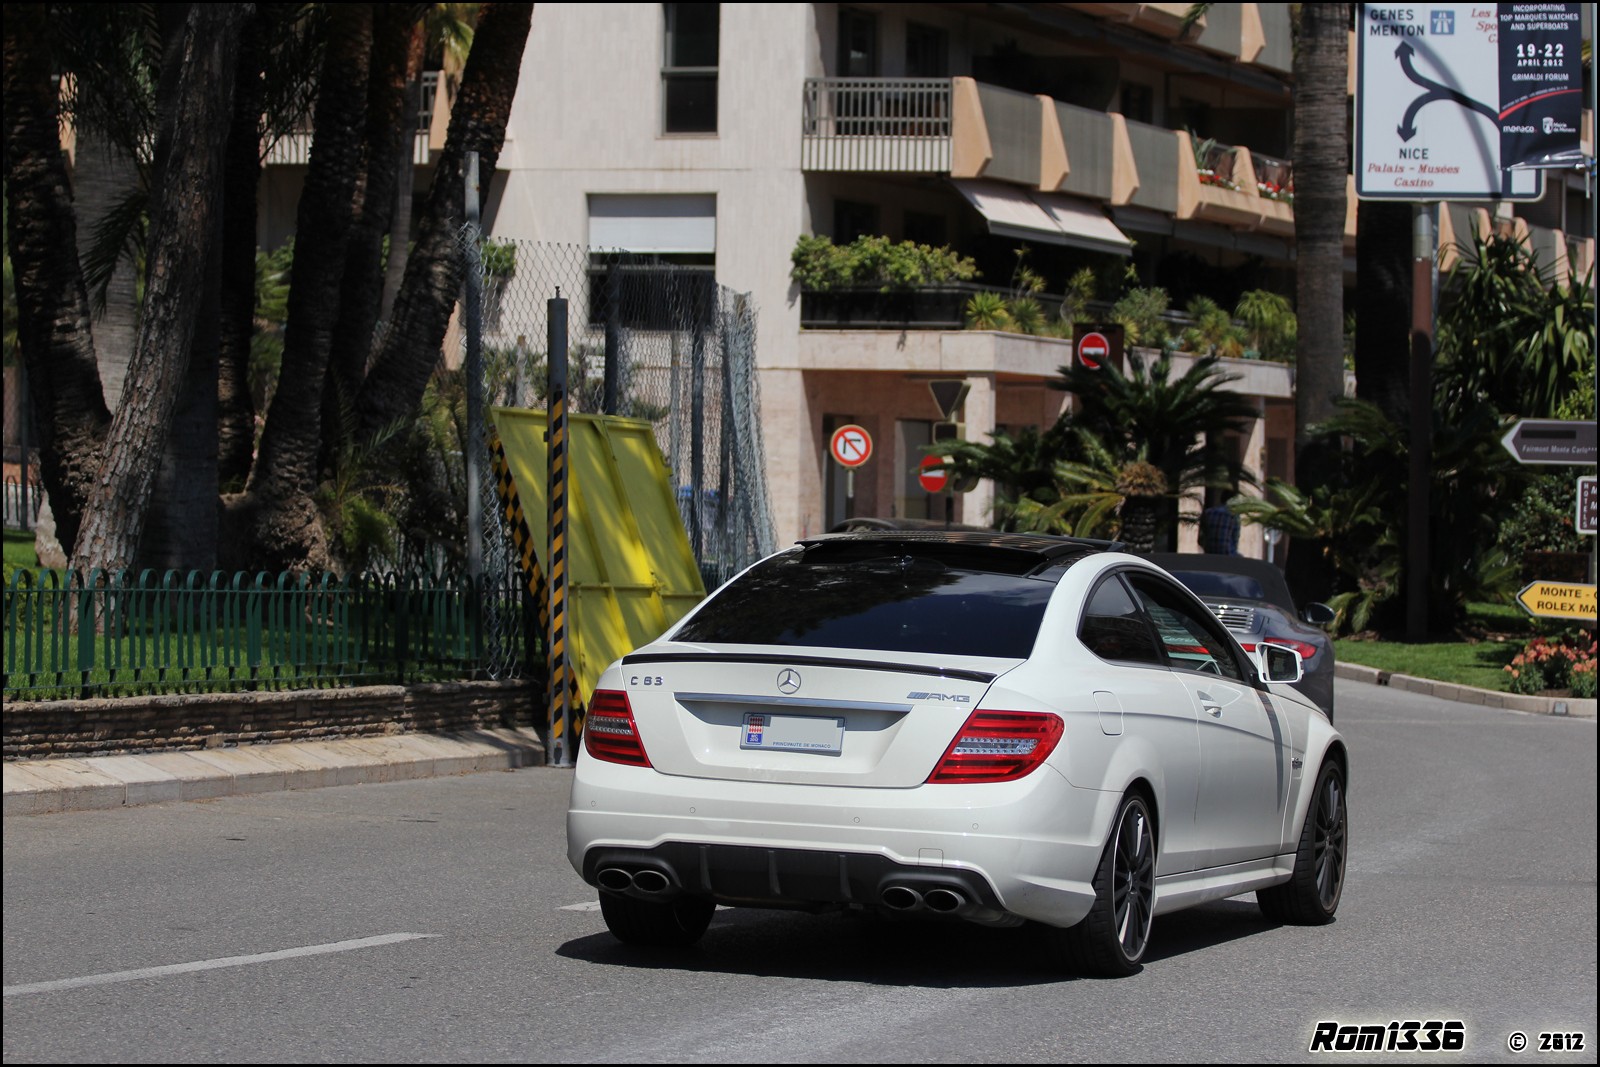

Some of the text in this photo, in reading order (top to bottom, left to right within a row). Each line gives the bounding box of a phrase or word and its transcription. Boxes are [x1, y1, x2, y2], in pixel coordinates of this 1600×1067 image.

[1471, 8, 1491, 18] Les
[1513, 4, 1565, 12] INCORPORATING
[1370, 9, 1414, 20] GENES
[1514, 13, 1547, 22] MARQUES
[1370, 24, 1424, 36] MENTON
[1527, 22, 1569, 30] SUPERBOATS
[1517, 59, 1563, 67] APRIL 2012
[1511, 73, 1569, 81] GRIMALDI FORUM
[1399, 148, 1429, 160] NICE
[1368, 163, 1404, 173] Palais
[1418, 164, 1460, 174] Musées
[1394, 178, 1434, 187] Casino
[1540, 586, 1581, 598] MONTE
[1537, 600, 1575, 612] ROLEX
[630, 676, 663, 686] C 63
[927, 693, 970, 703] AMG
